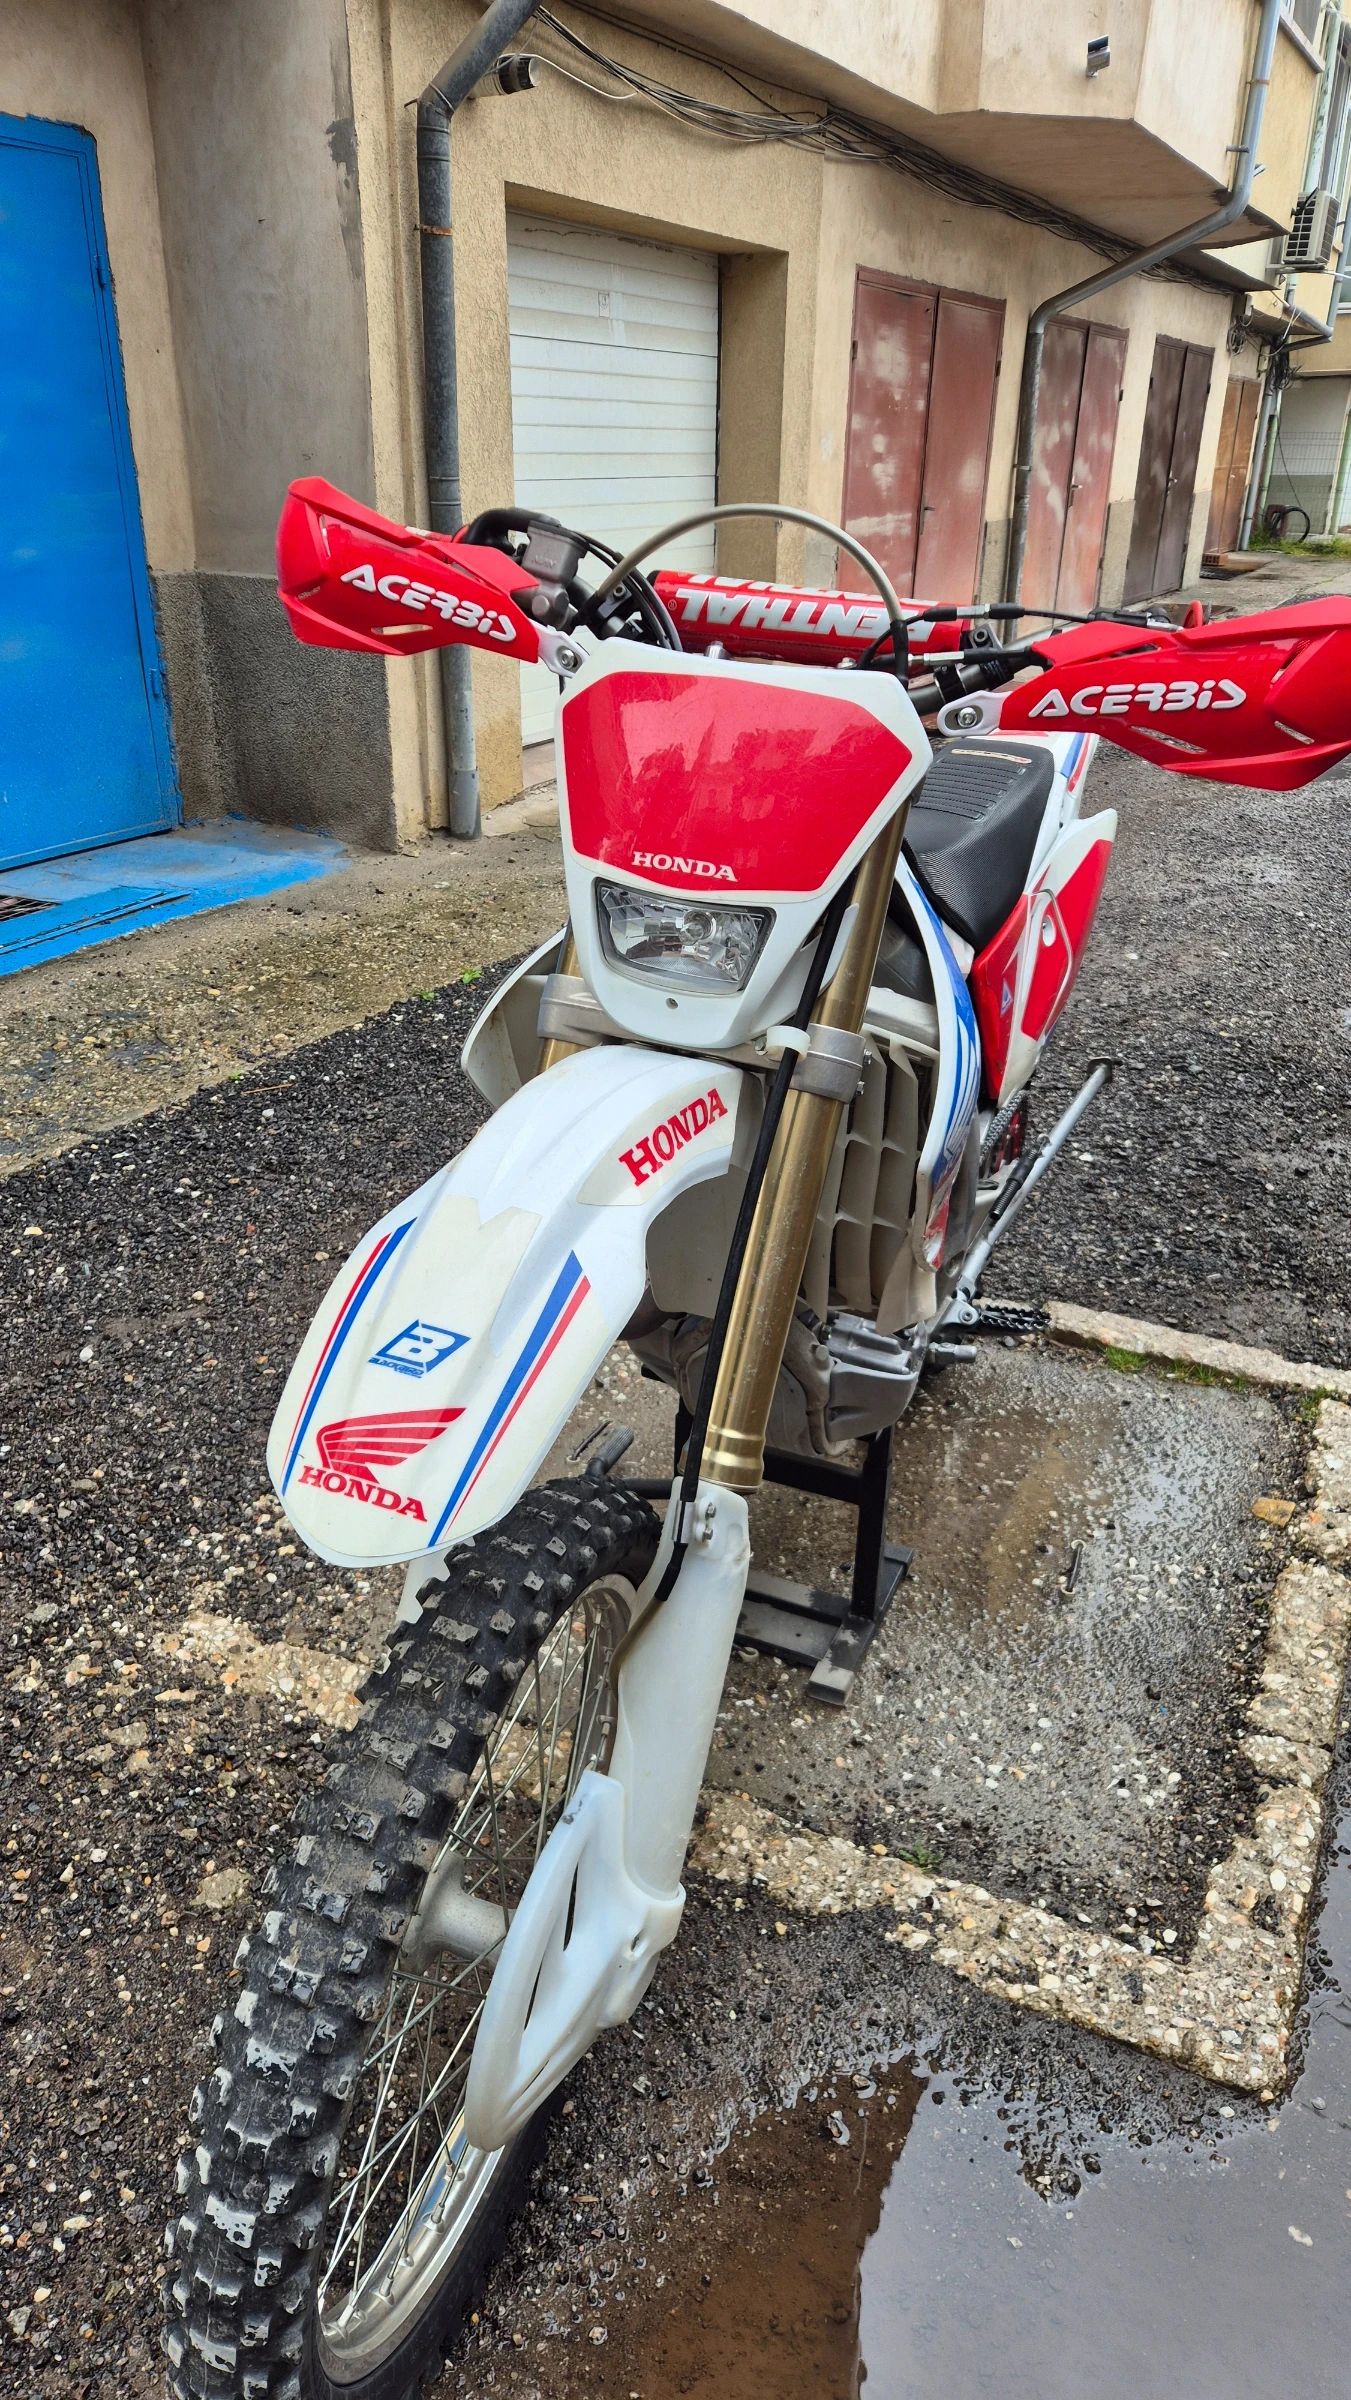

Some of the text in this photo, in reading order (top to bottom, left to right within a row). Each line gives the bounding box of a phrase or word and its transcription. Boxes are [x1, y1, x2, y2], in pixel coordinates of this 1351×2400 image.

[631, 850, 739, 883] HONDA
[618, 1087, 729, 1187] HONDA
[298, 1465, 429, 1522] HONDA
